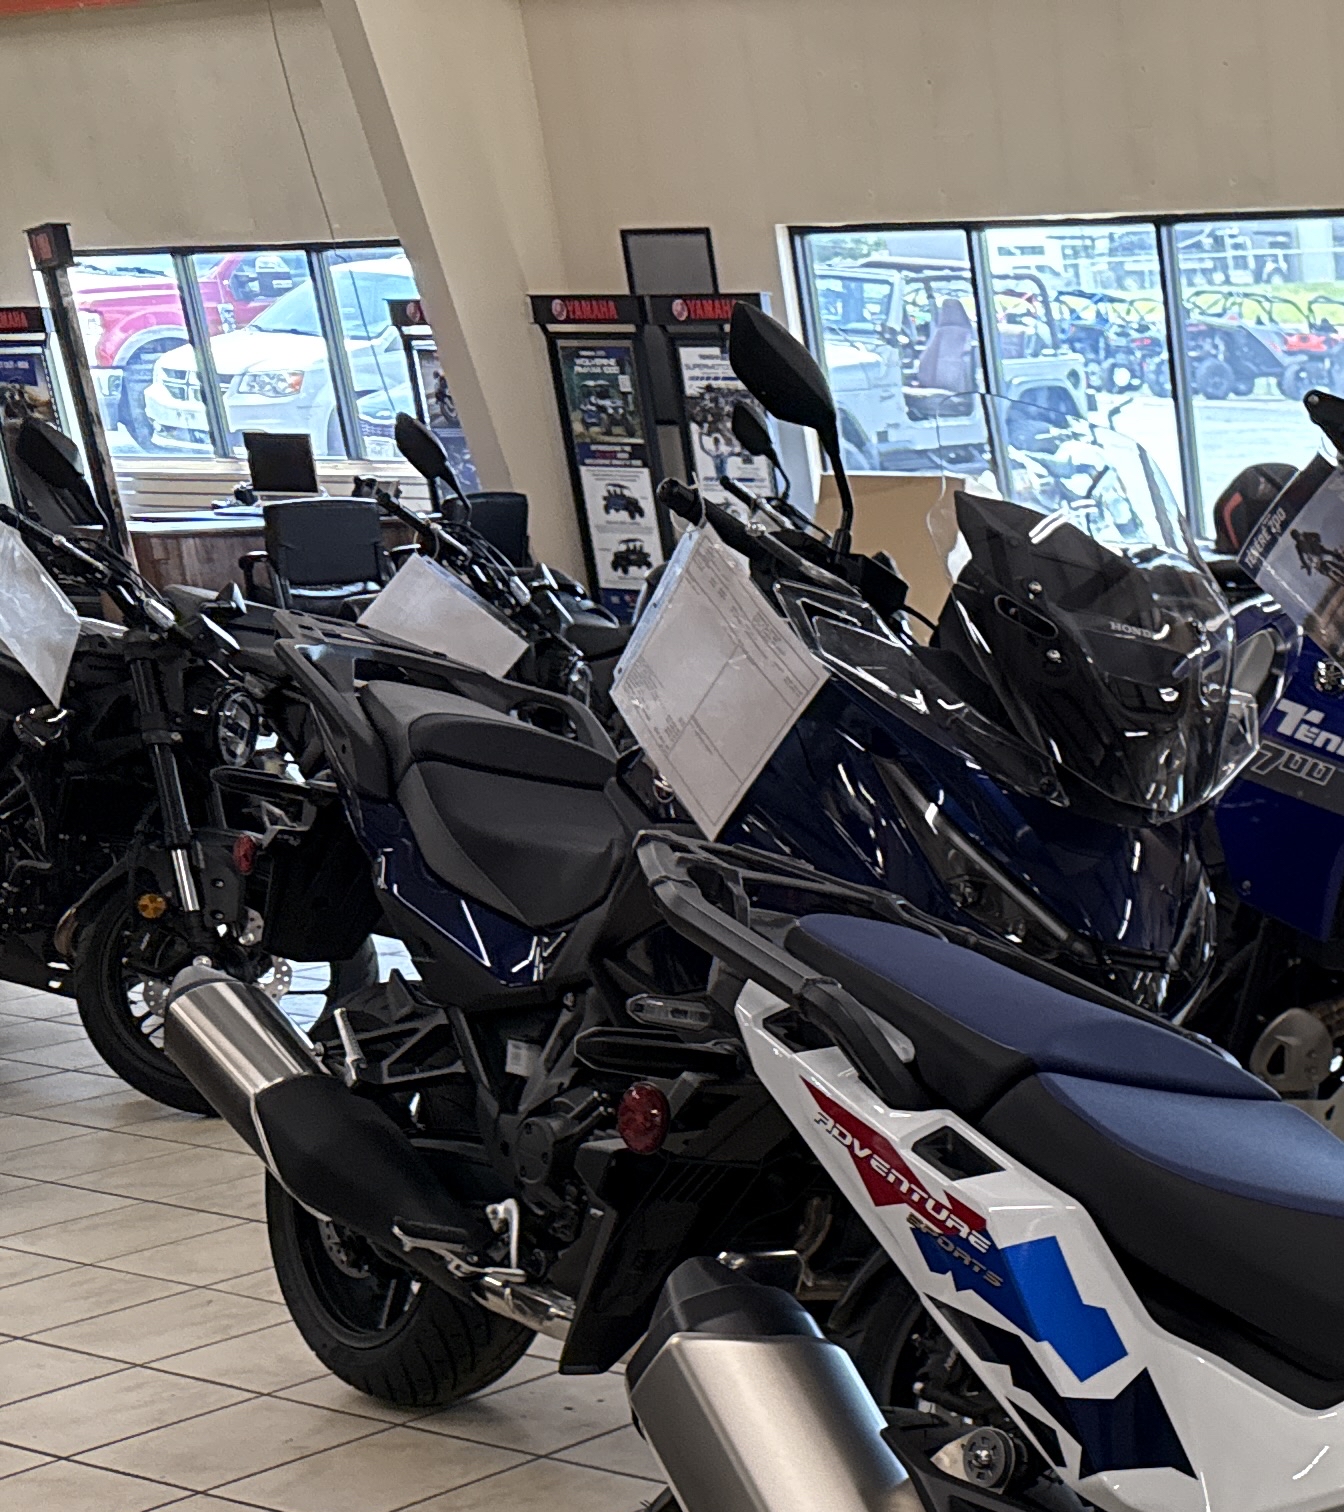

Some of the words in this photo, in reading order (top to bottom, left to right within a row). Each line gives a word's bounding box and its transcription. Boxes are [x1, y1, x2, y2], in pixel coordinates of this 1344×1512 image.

[566, 299, 619, 320] YAMAHA
[1109, 621, 1157, 639] HOND
[1250, 740, 1336, 787] 700
[813, 1110, 994, 1255] ADVENTURE
[905, 1211, 1005, 1289] SPORTS
